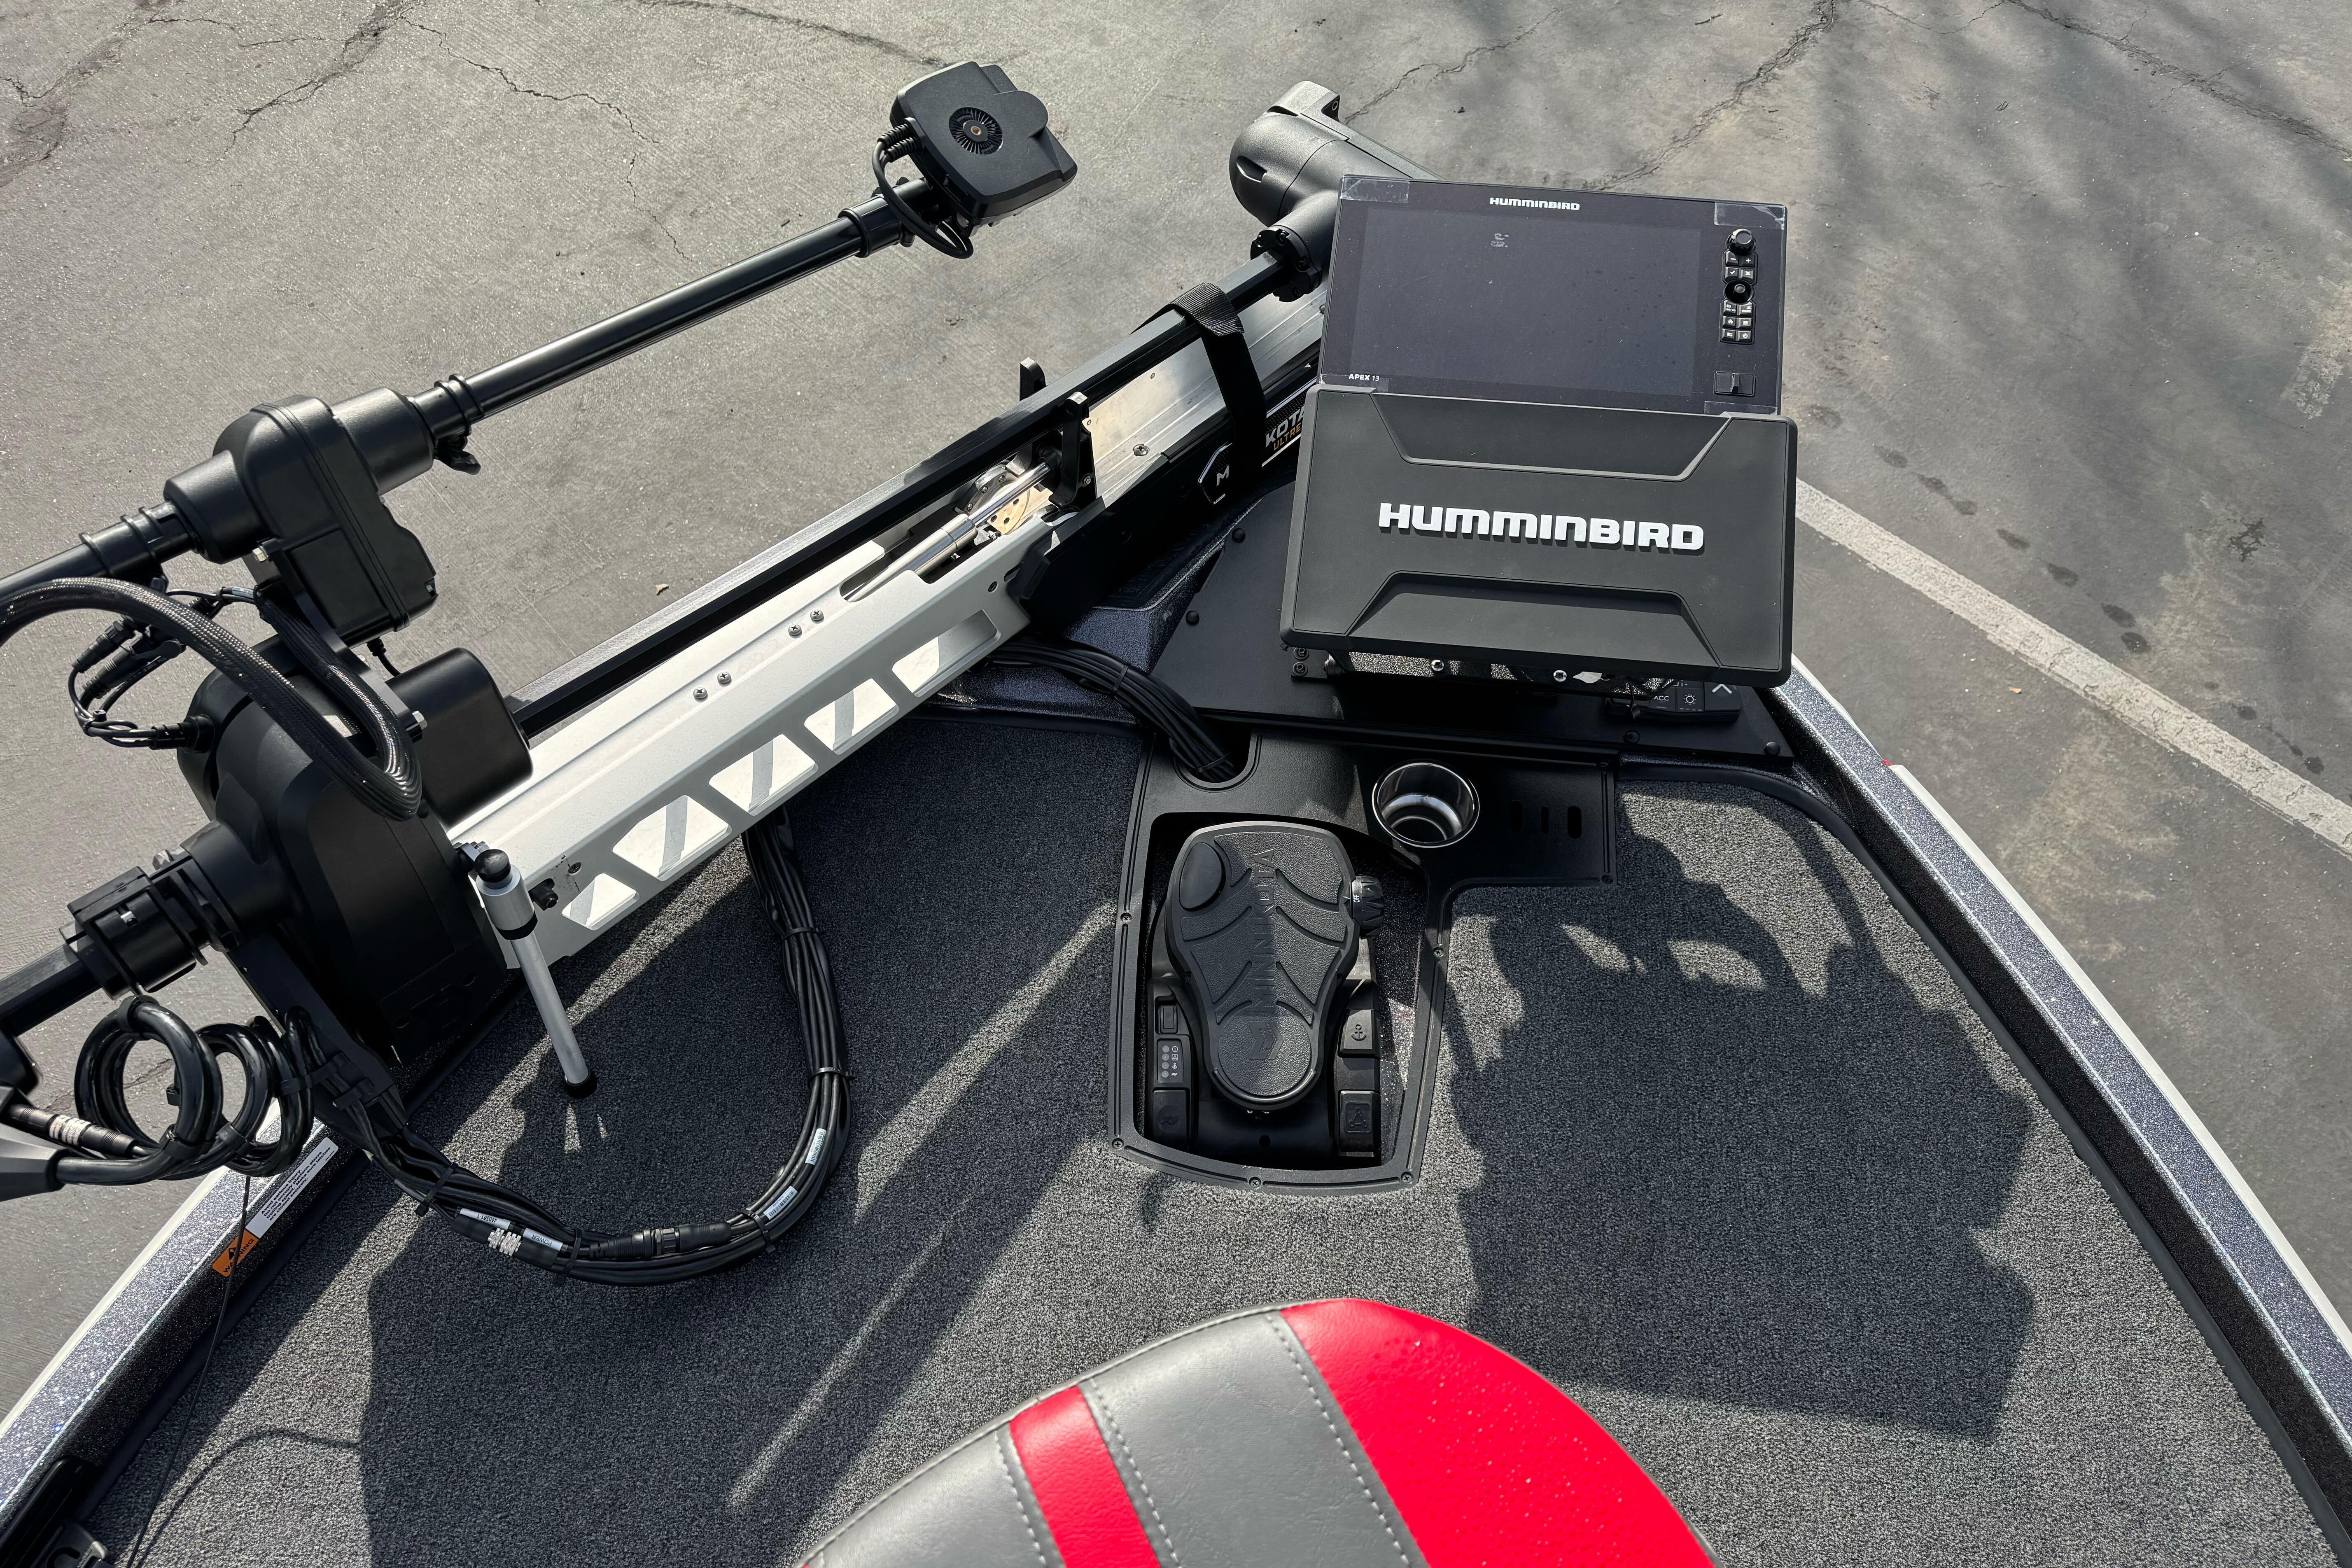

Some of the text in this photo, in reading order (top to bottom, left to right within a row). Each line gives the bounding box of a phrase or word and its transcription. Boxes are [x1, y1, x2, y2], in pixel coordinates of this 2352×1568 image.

[1490, 197, 1580, 210] HUMMINBIRD
[1273, 422, 1302, 451] ULTRE
[1378, 502, 1704, 550] HUMMINBIRD
[1253, 848, 1275, 925] KOTA
[223, 1239, 254, 1272] WANING
[532, 1234, 553, 1246] POWER
